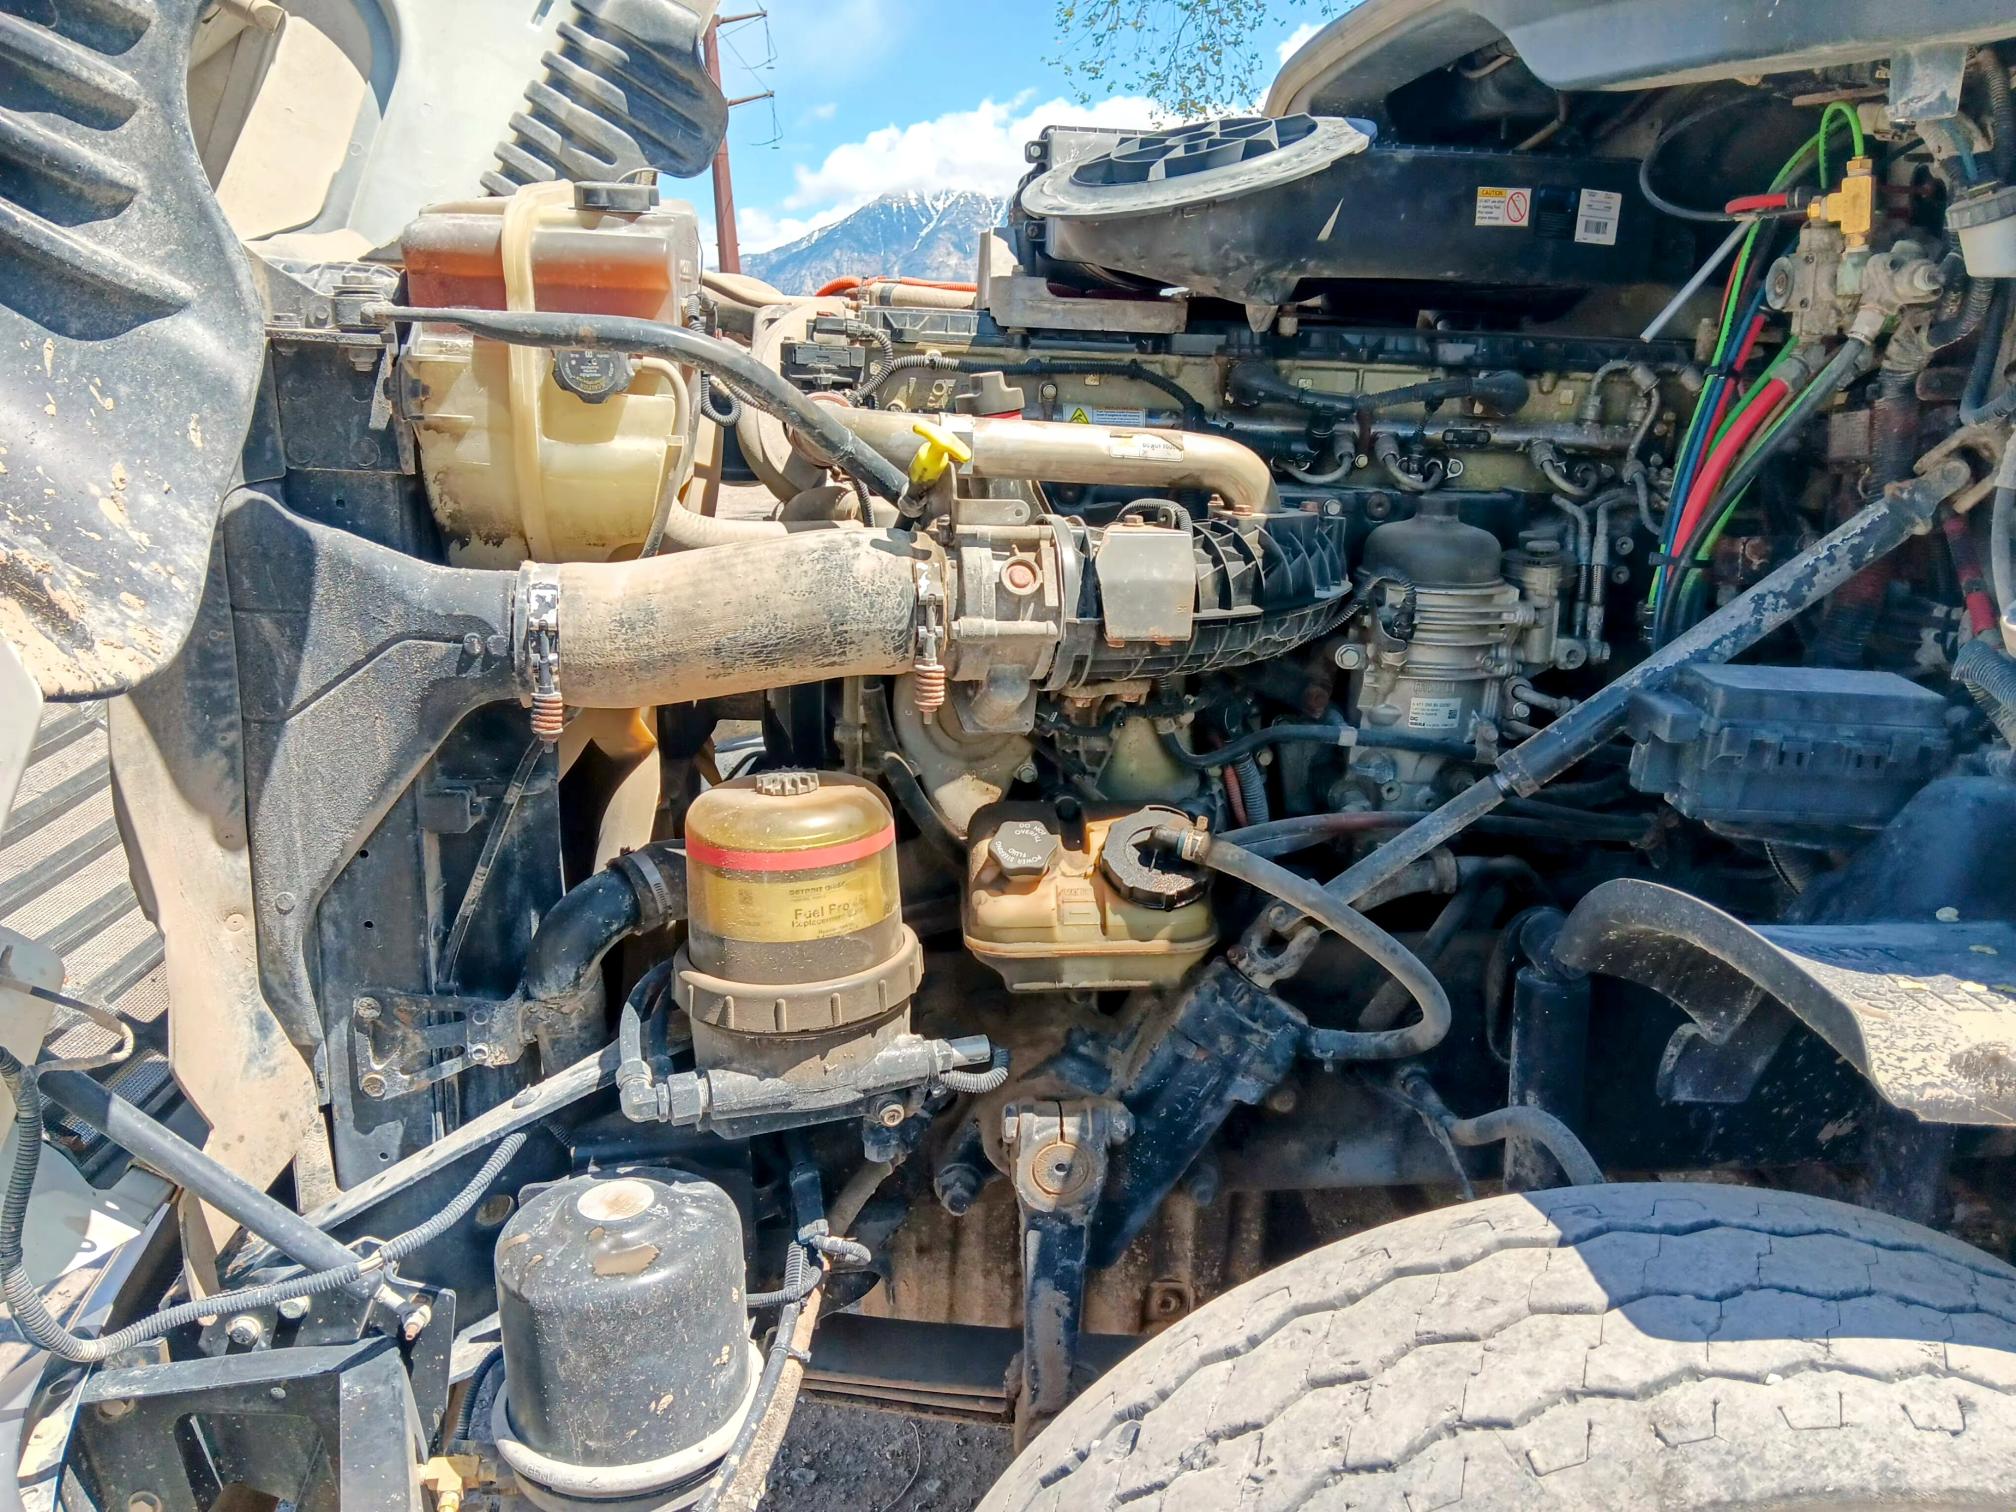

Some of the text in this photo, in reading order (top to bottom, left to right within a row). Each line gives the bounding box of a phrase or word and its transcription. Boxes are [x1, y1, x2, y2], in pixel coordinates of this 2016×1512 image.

[1014, 829, 1042, 843] OVERFILL
[1033, 826, 1047, 836] NOT
[1008, 847, 1027, 858] FLUID
[1017, 854, 1042, 865] POWER
[794, 906, 824, 919] Fuel
